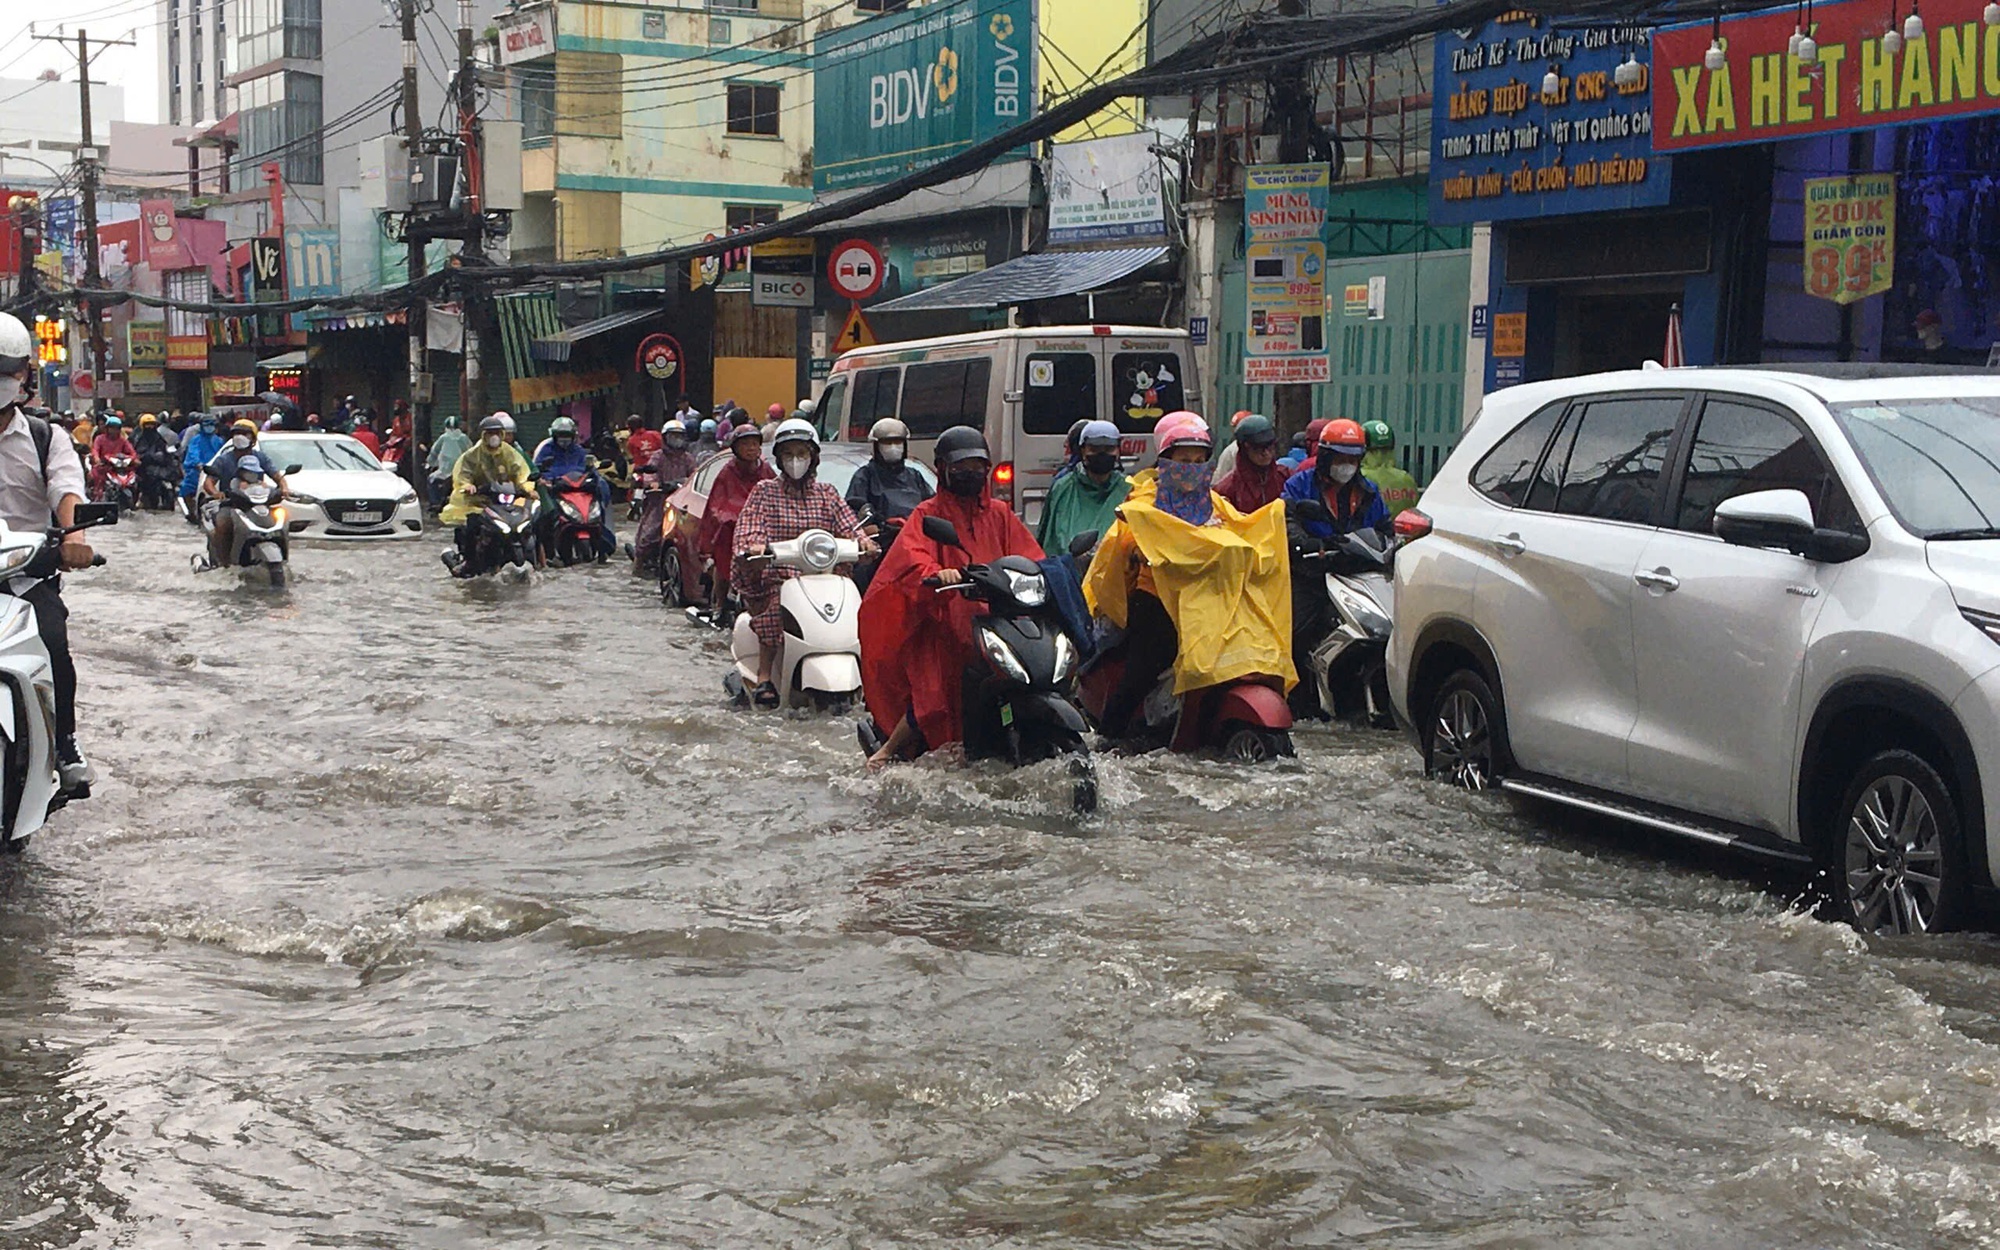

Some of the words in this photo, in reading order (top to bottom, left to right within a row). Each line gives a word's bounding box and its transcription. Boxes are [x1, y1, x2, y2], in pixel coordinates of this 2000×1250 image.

[1489, 39, 1507, 66] Kế
[870, 62, 935, 129] BIDV
[995, 40, 1018, 116] BIDV
[1450, 82, 1488, 118] BẢNG
[1494, 77, 1529, 117] HIỆU
[1576, 71, 1607, 101] CNC
[1671, 37, 1736, 137] XẢ
[1751, 22, 1847, 127] HẾT
[1442, 137, 1472, 158] TRANG
[1476, 129, 1491, 154] TRÍ
[1514, 121, 1540, 149] THẤT
[1551, 119, 1570, 152] VẬT
[1574, 117, 1589, 143] TƯ
[1591, 109, 1628, 141] QUẢNG
[1444, 170, 1474, 199] NHÔM
[1477, 166, 1503, 197] KÍNH
[1511, 160, 1533, 193] CỬA
[1600, 153, 1627, 183] HIÊN
[1249, 211, 1285, 226] SINH
[1813, 225, 1851, 240] GIẢM
[1815, 200, 1884, 225] 200K
[289, 232, 332, 287] in
